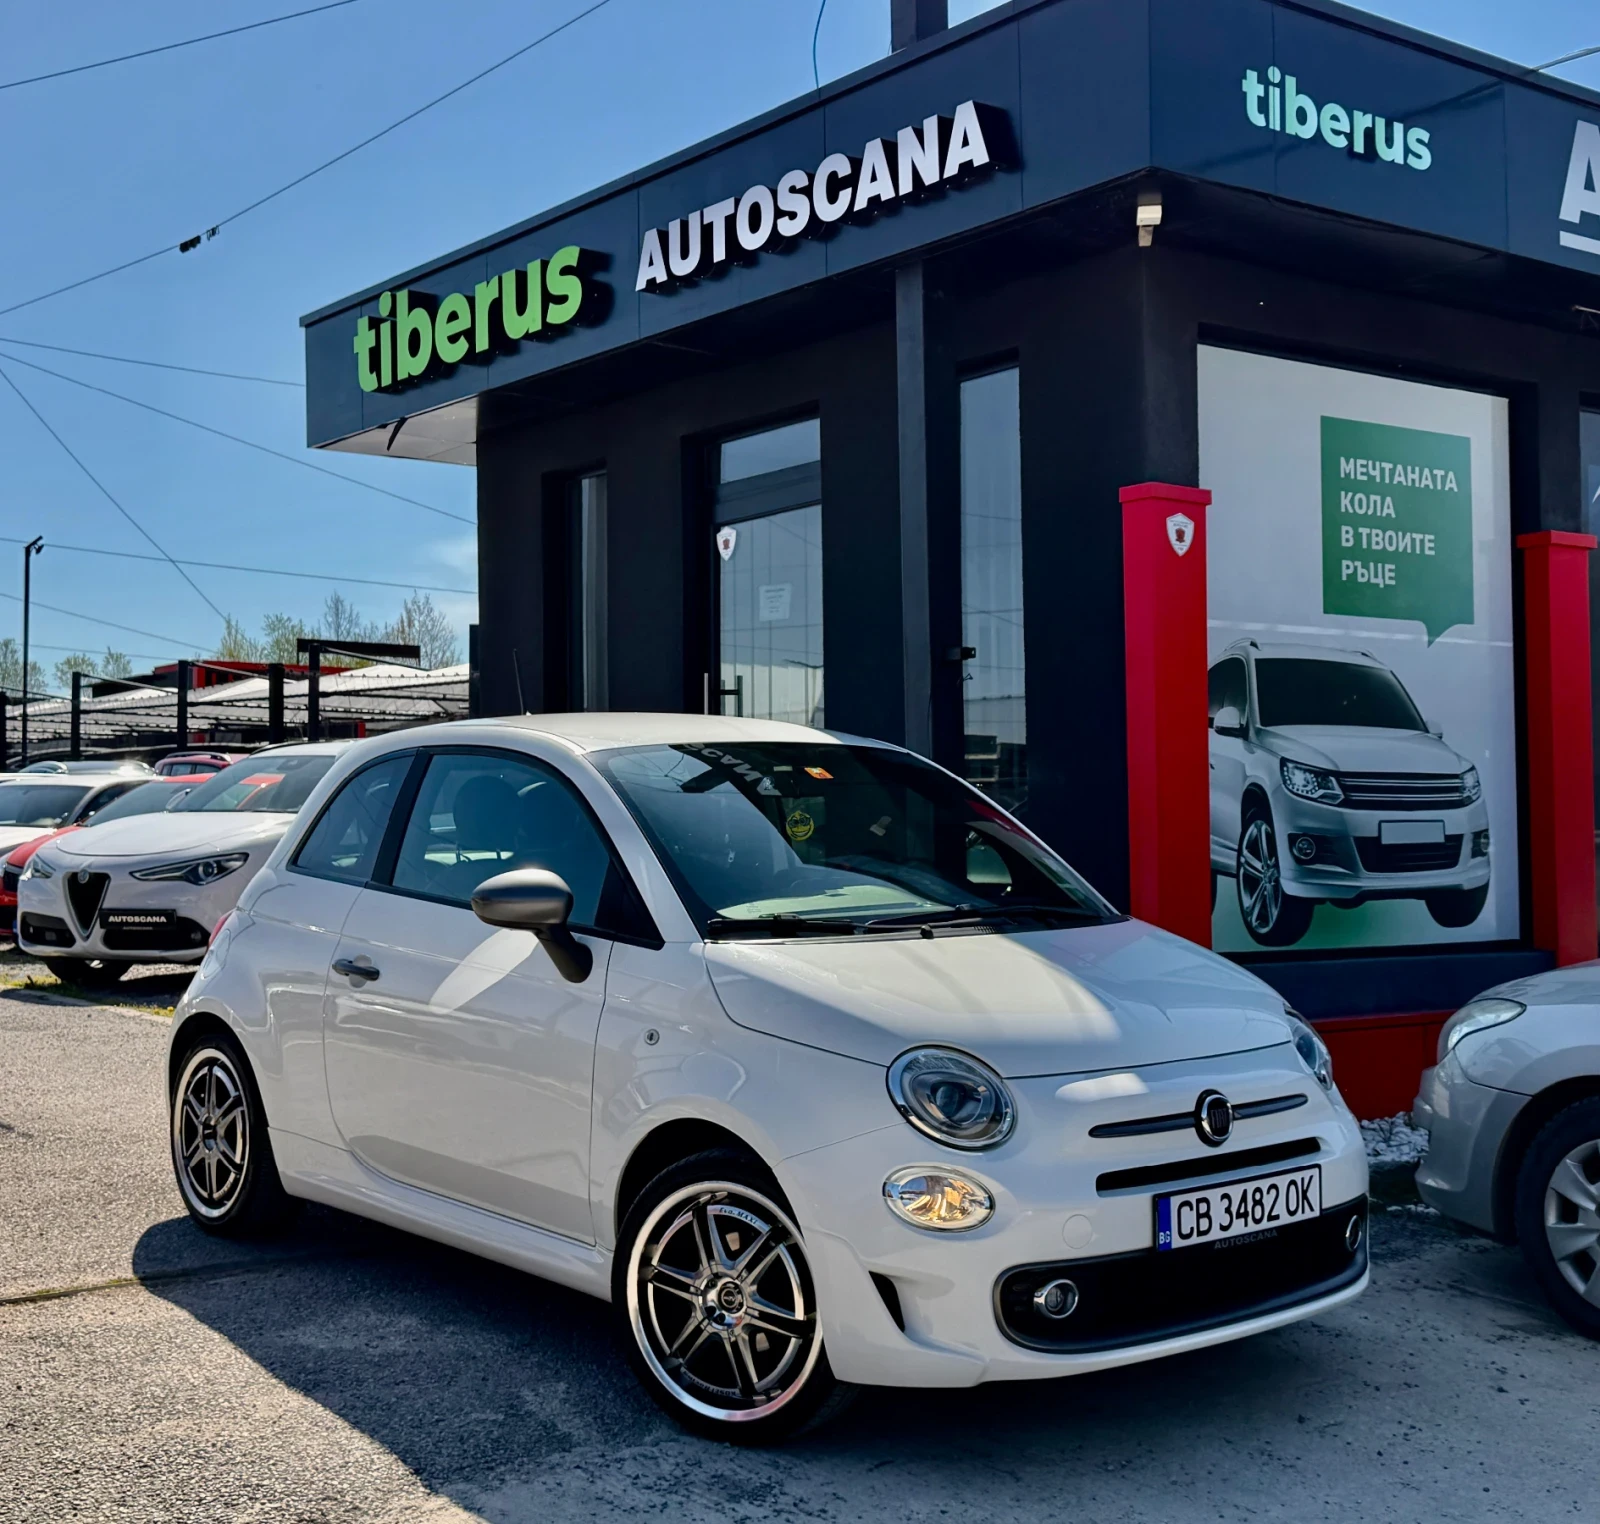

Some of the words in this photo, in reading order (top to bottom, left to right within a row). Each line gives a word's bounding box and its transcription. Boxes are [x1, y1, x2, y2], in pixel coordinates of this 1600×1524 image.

[1242, 66, 1432, 171] tiberus
[636, 100, 990, 292] AUTOSCANA
[354, 246, 583, 392] tiberus
[1340, 457, 1458, 492] МЕЧТАНАТА
[1340, 491, 1396, 518] КОЛА
[1341, 525, 1355, 547] В
[1358, 527, 1435, 555] ТВОИТЕ
[1341, 559, 1396, 588] РЪЦЕ
[108, 915, 167, 923] AUTOSCANA
[1177, 1196, 1213, 1240] CB
[1219, 1183, 1280, 1232] 3482
[1285, 1175, 1315, 1216] OK
[1159, 1231, 1171, 1243] BG
[1214, 1230, 1278, 1249] AUTOSCANA
